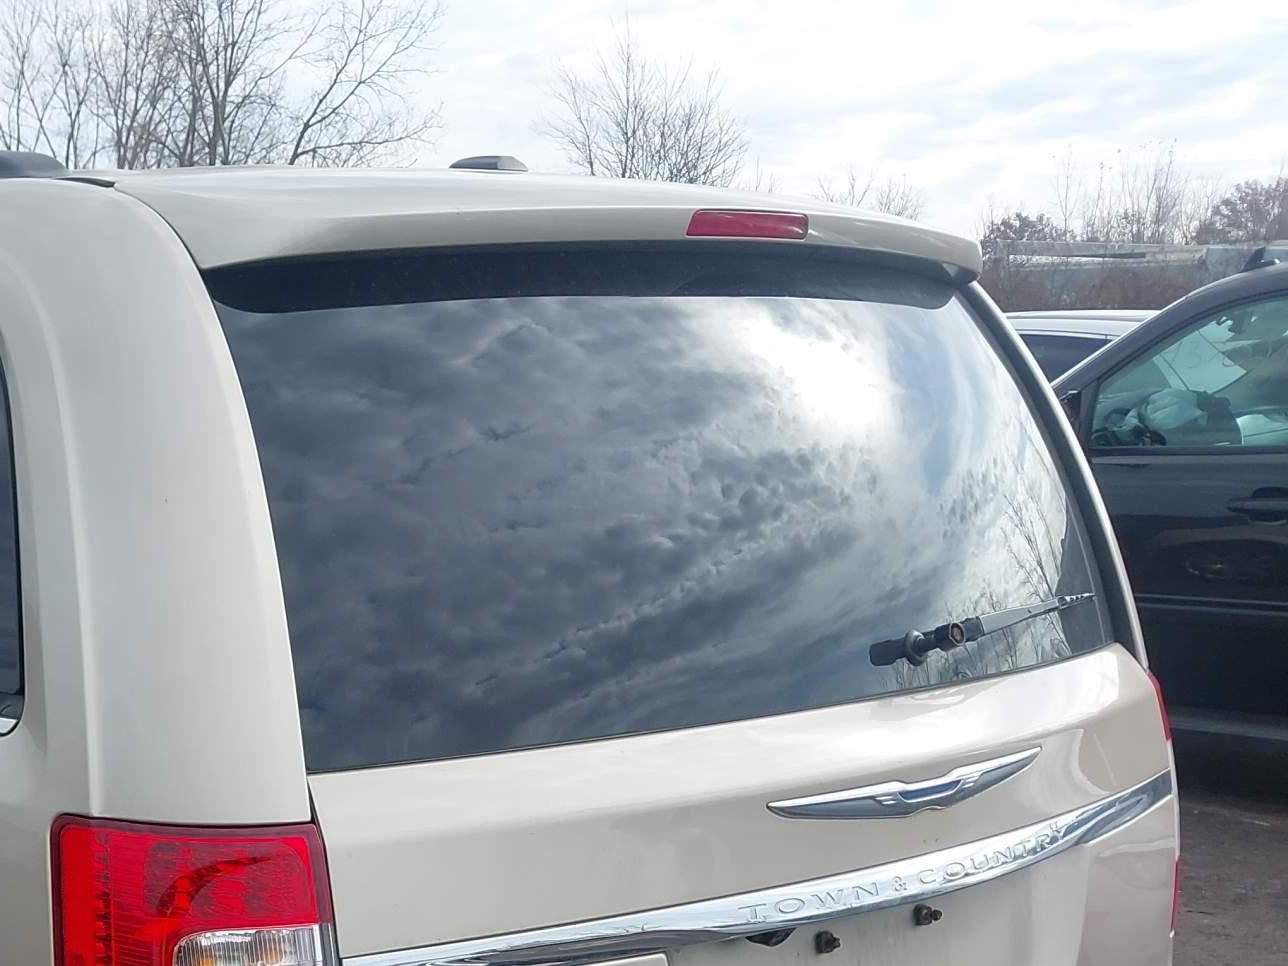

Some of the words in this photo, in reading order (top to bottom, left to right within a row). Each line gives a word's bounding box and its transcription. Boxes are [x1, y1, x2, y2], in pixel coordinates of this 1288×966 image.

[737, 880, 879, 924] TOWN
[893, 875, 908, 892] &
[918, 822, 1065, 886] COUNTRY
